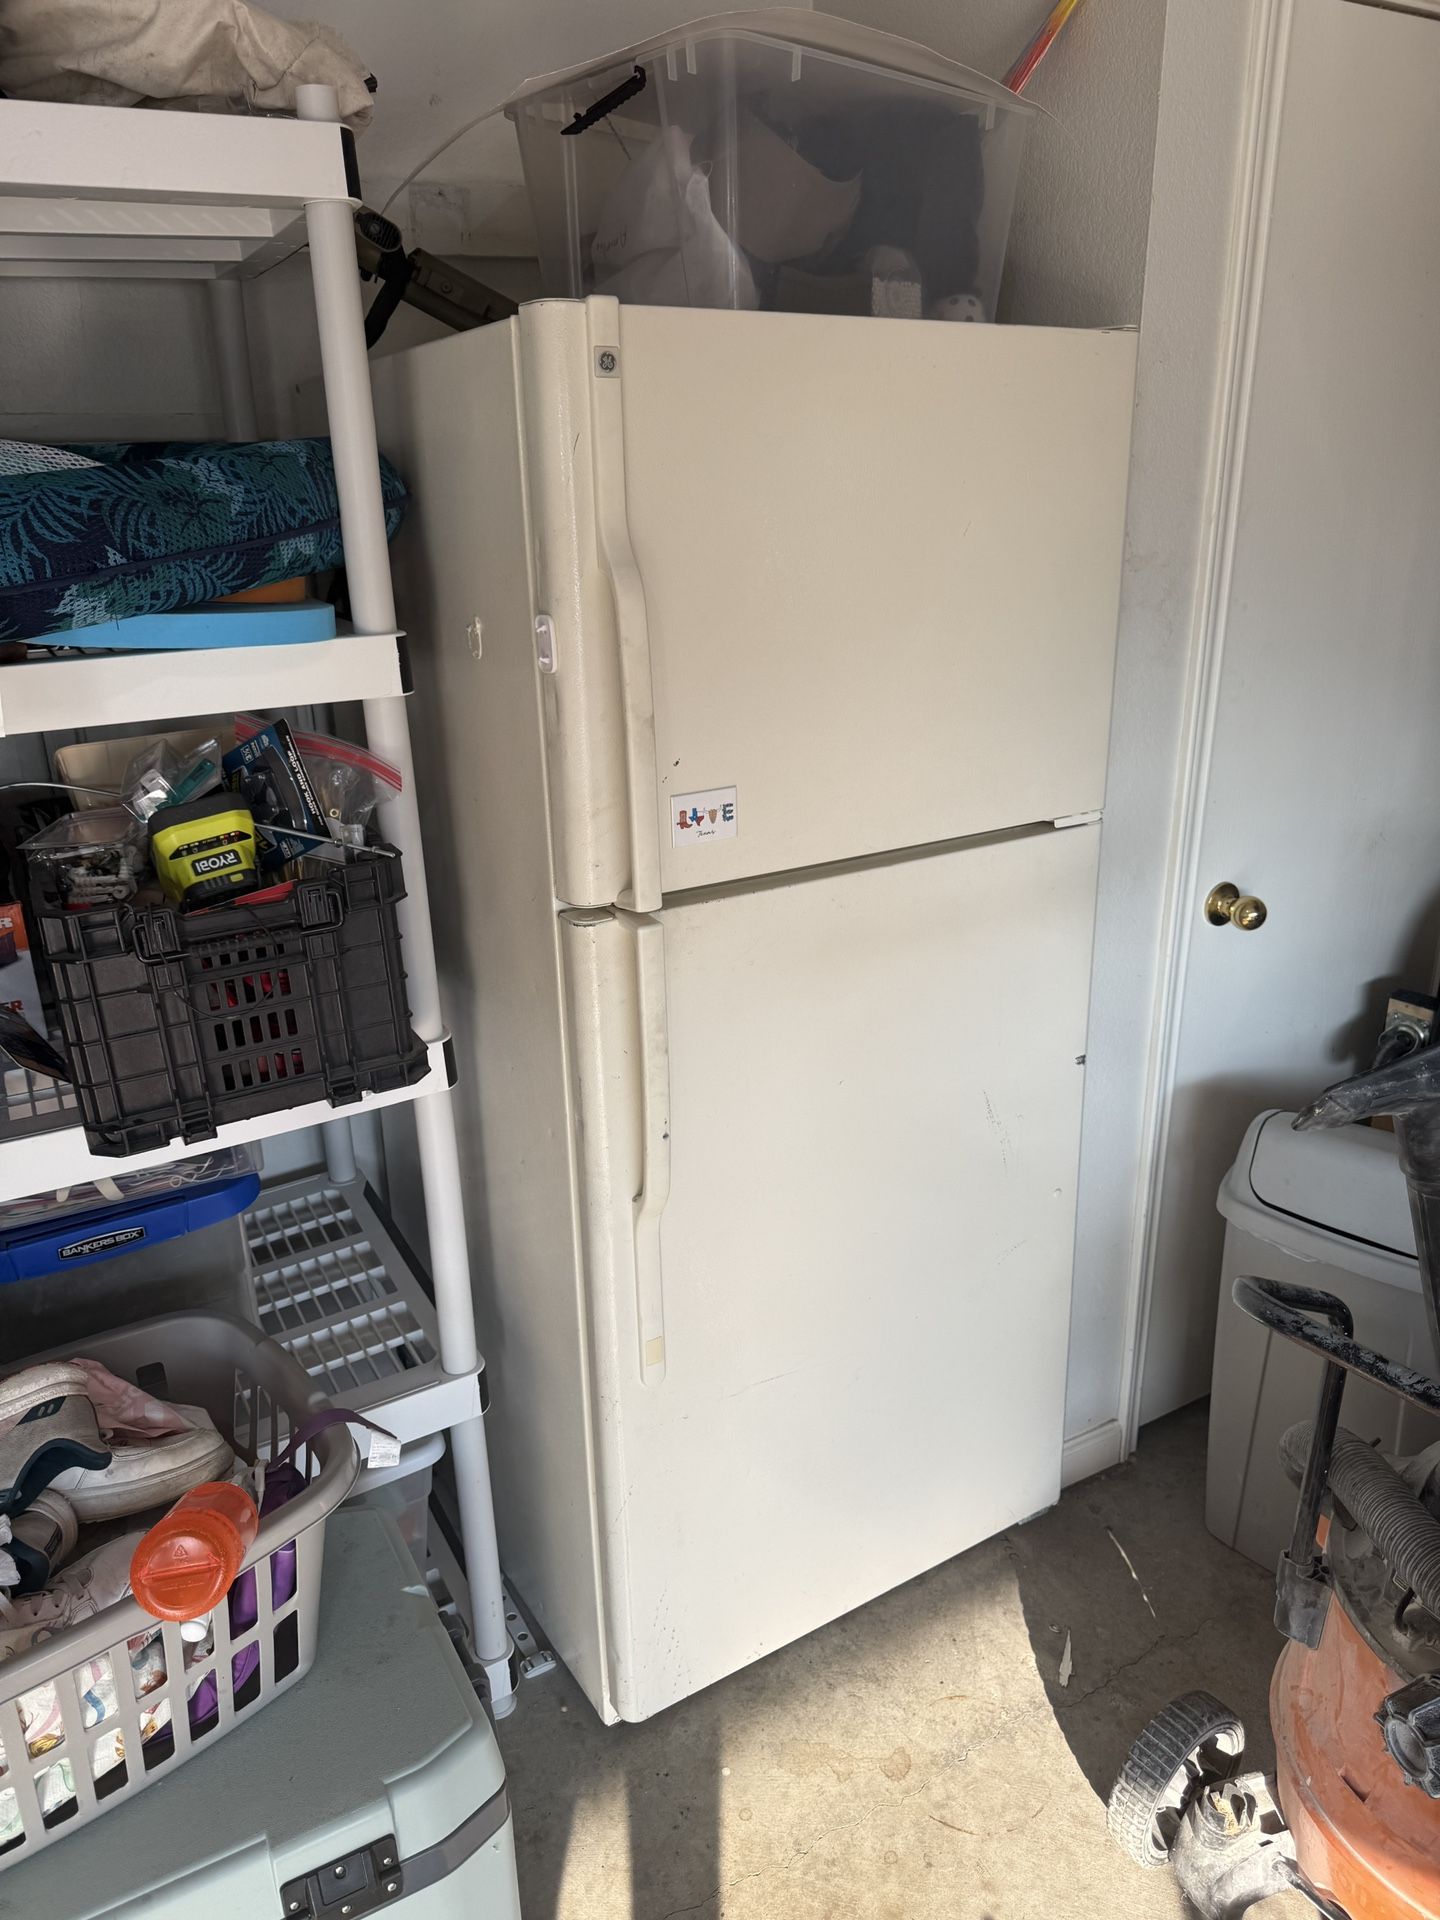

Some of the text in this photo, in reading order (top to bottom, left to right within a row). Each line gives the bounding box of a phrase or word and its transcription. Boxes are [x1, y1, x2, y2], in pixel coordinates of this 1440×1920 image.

[287, 750, 298, 774] LOOP
[296, 768, 306, 790] AND
[303, 791, 315, 815] HOOK
[195, 852, 237, 873] RYOBI
[62, 1236, 115, 1257] BANKERS
